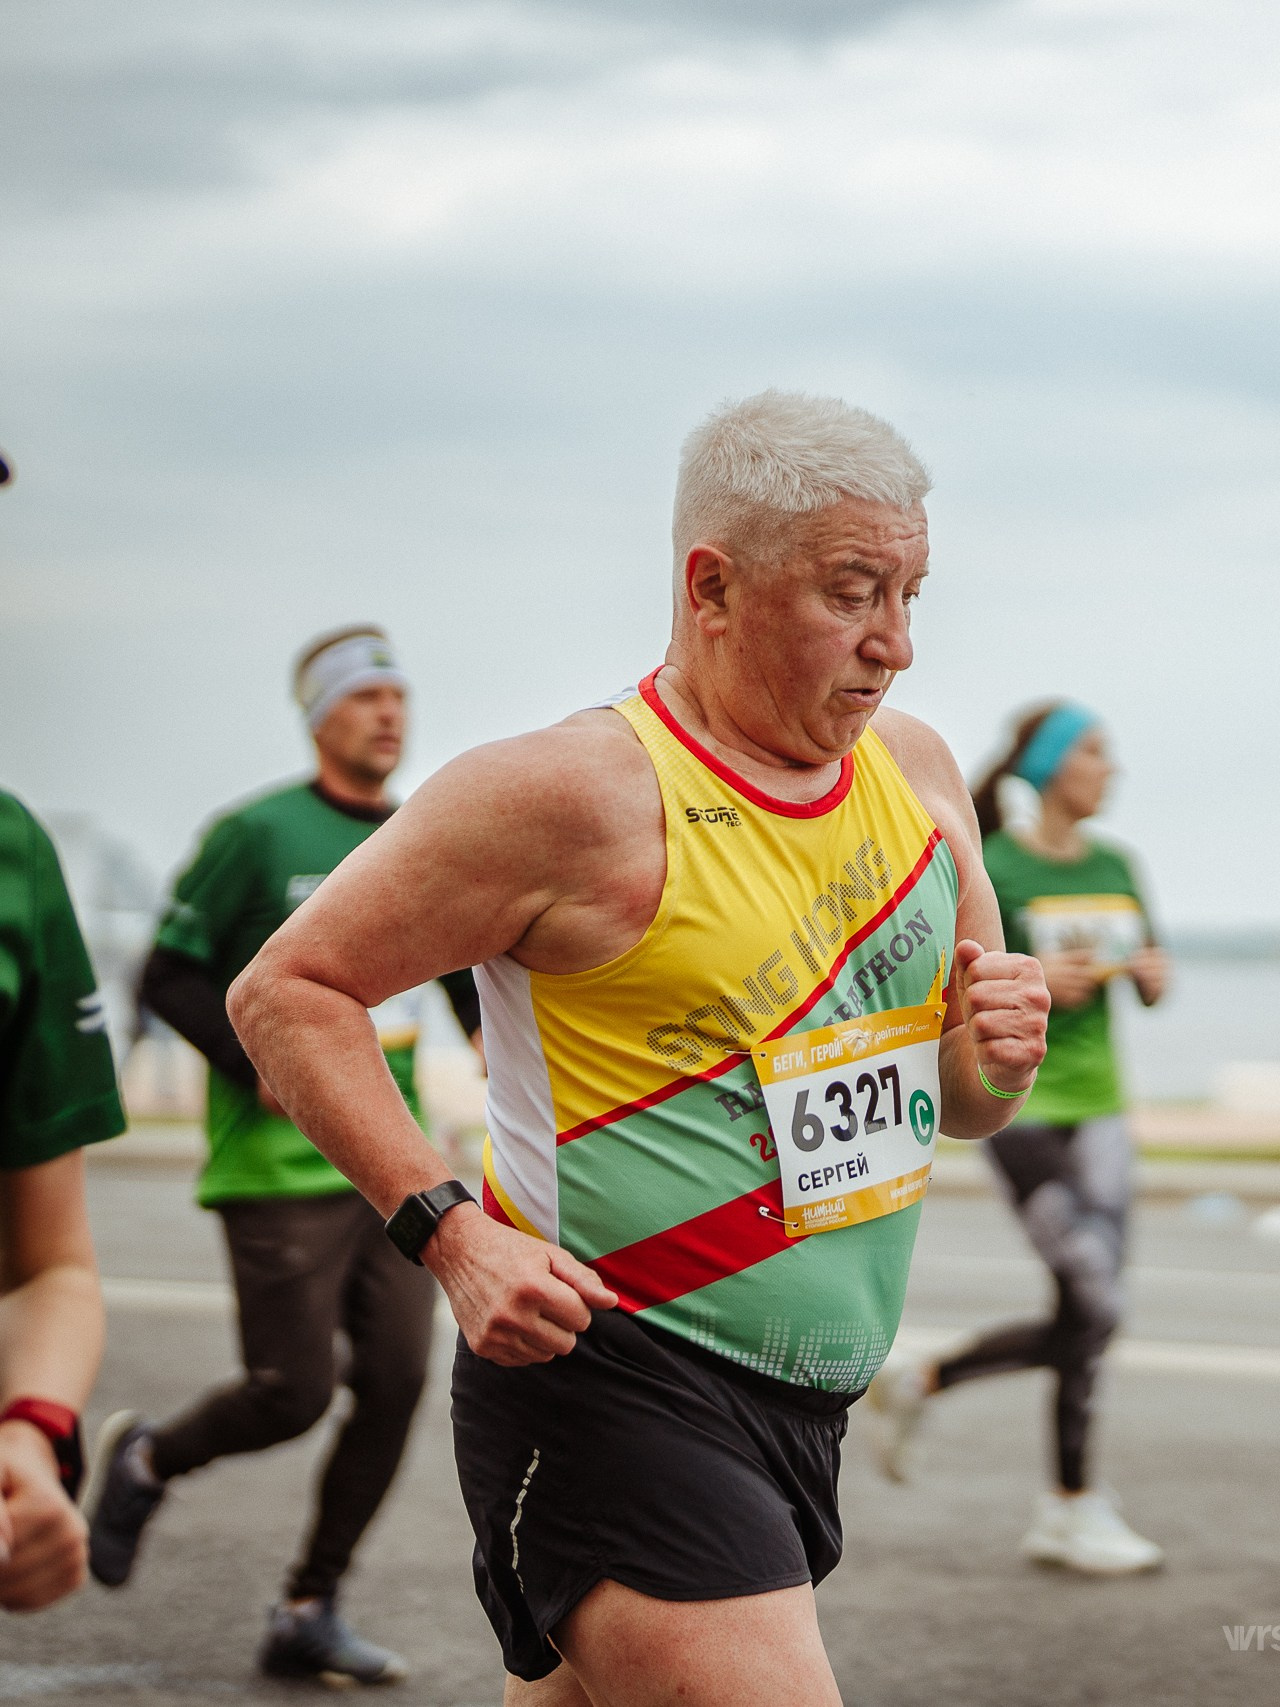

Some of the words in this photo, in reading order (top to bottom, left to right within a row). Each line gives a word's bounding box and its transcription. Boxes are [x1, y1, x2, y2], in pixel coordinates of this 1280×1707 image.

[646, 949, 799, 1071] SONG
[790, 835, 893, 974] HONG
[773, 1052, 808, 1074] БЕГИ,
[810, 1037, 844, 1063] ГЕРОЙ!
[791, 1063, 902, 1152] 6327
[798, 1152, 870, 1192] СЕРГЕЙ
